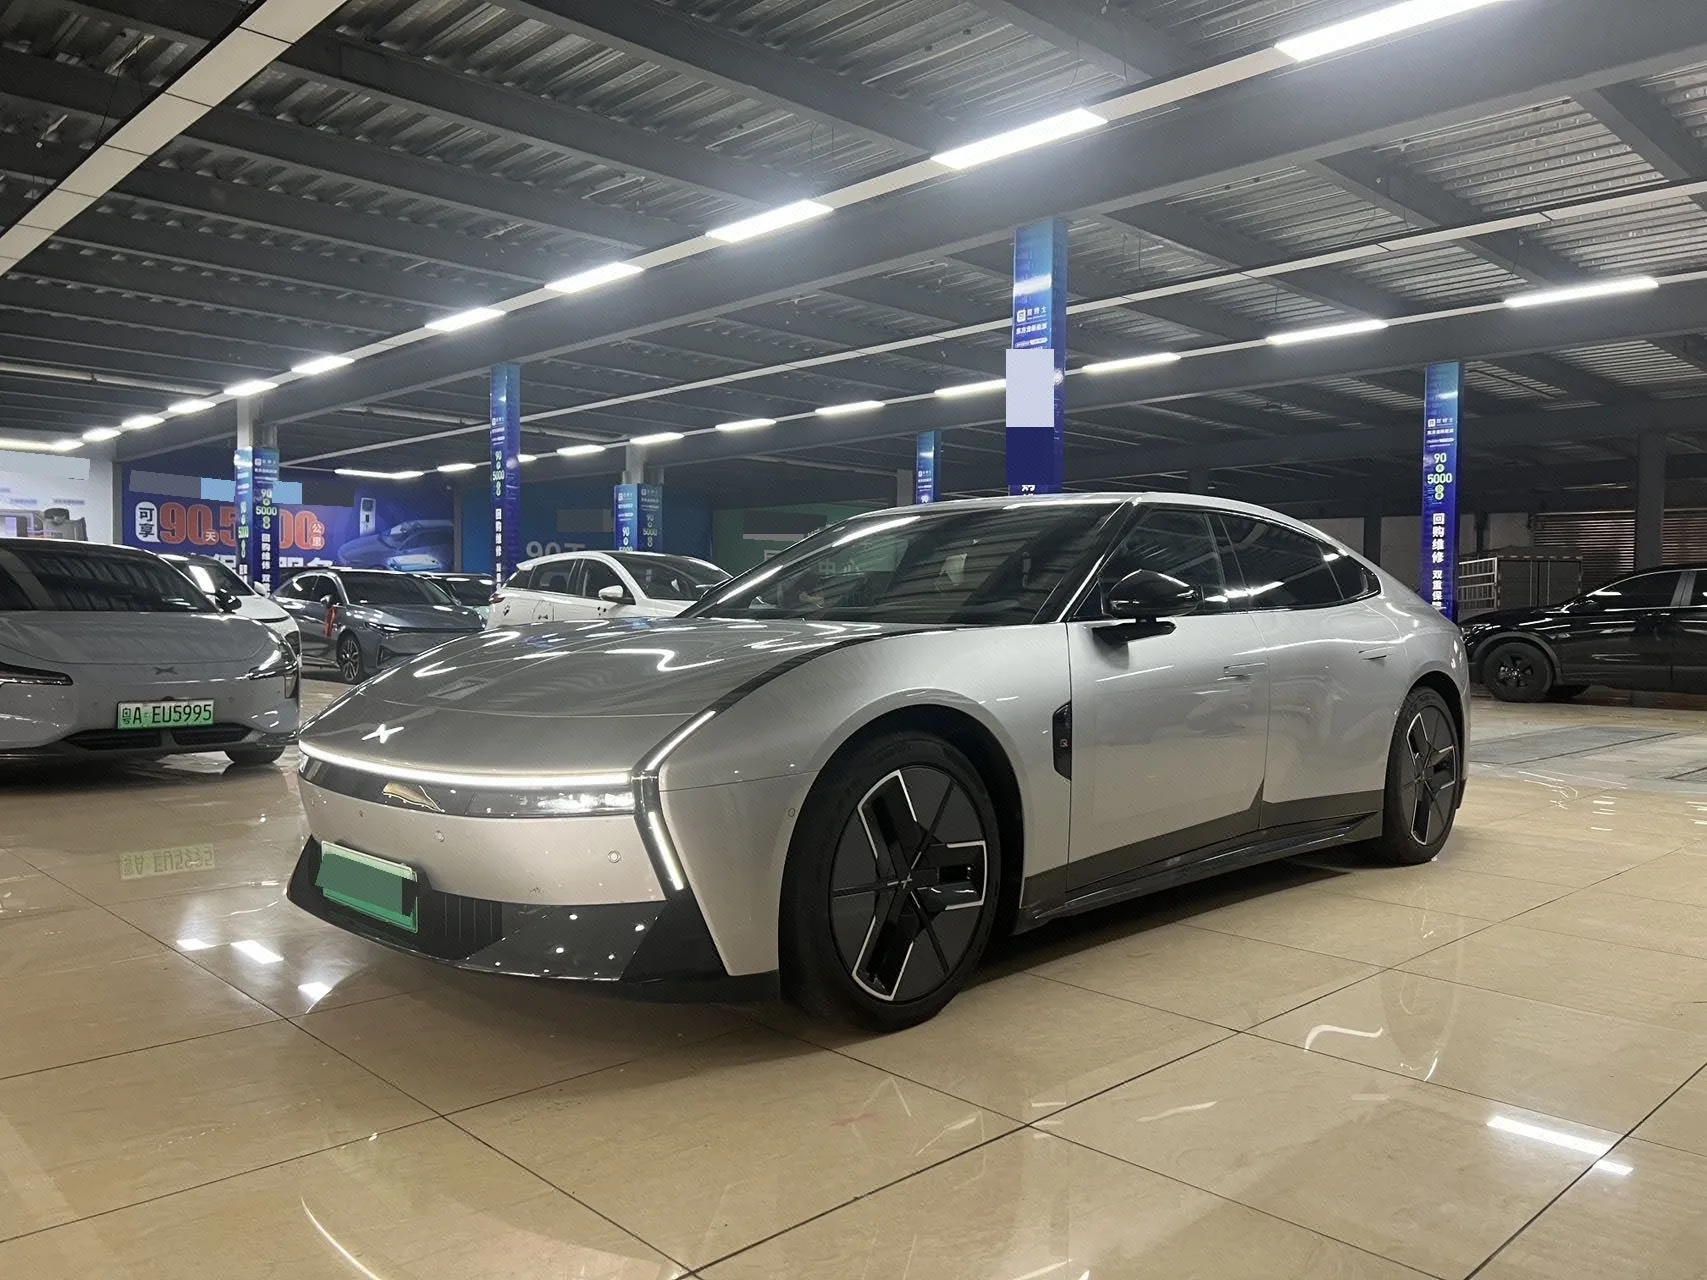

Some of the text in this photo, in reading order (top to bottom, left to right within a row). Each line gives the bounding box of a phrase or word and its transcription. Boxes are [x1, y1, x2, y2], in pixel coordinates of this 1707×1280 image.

[1434, 452, 1447, 463] 90
[1427, 473, 1453, 484] 5000
[256, 507, 277, 516] 5000
[139, 507, 155, 537] 可享
[159, 502, 213, 545] 90
[1432, 513, 1445, 563] 回购维修
[152, 704, 212, 723] EU5995
